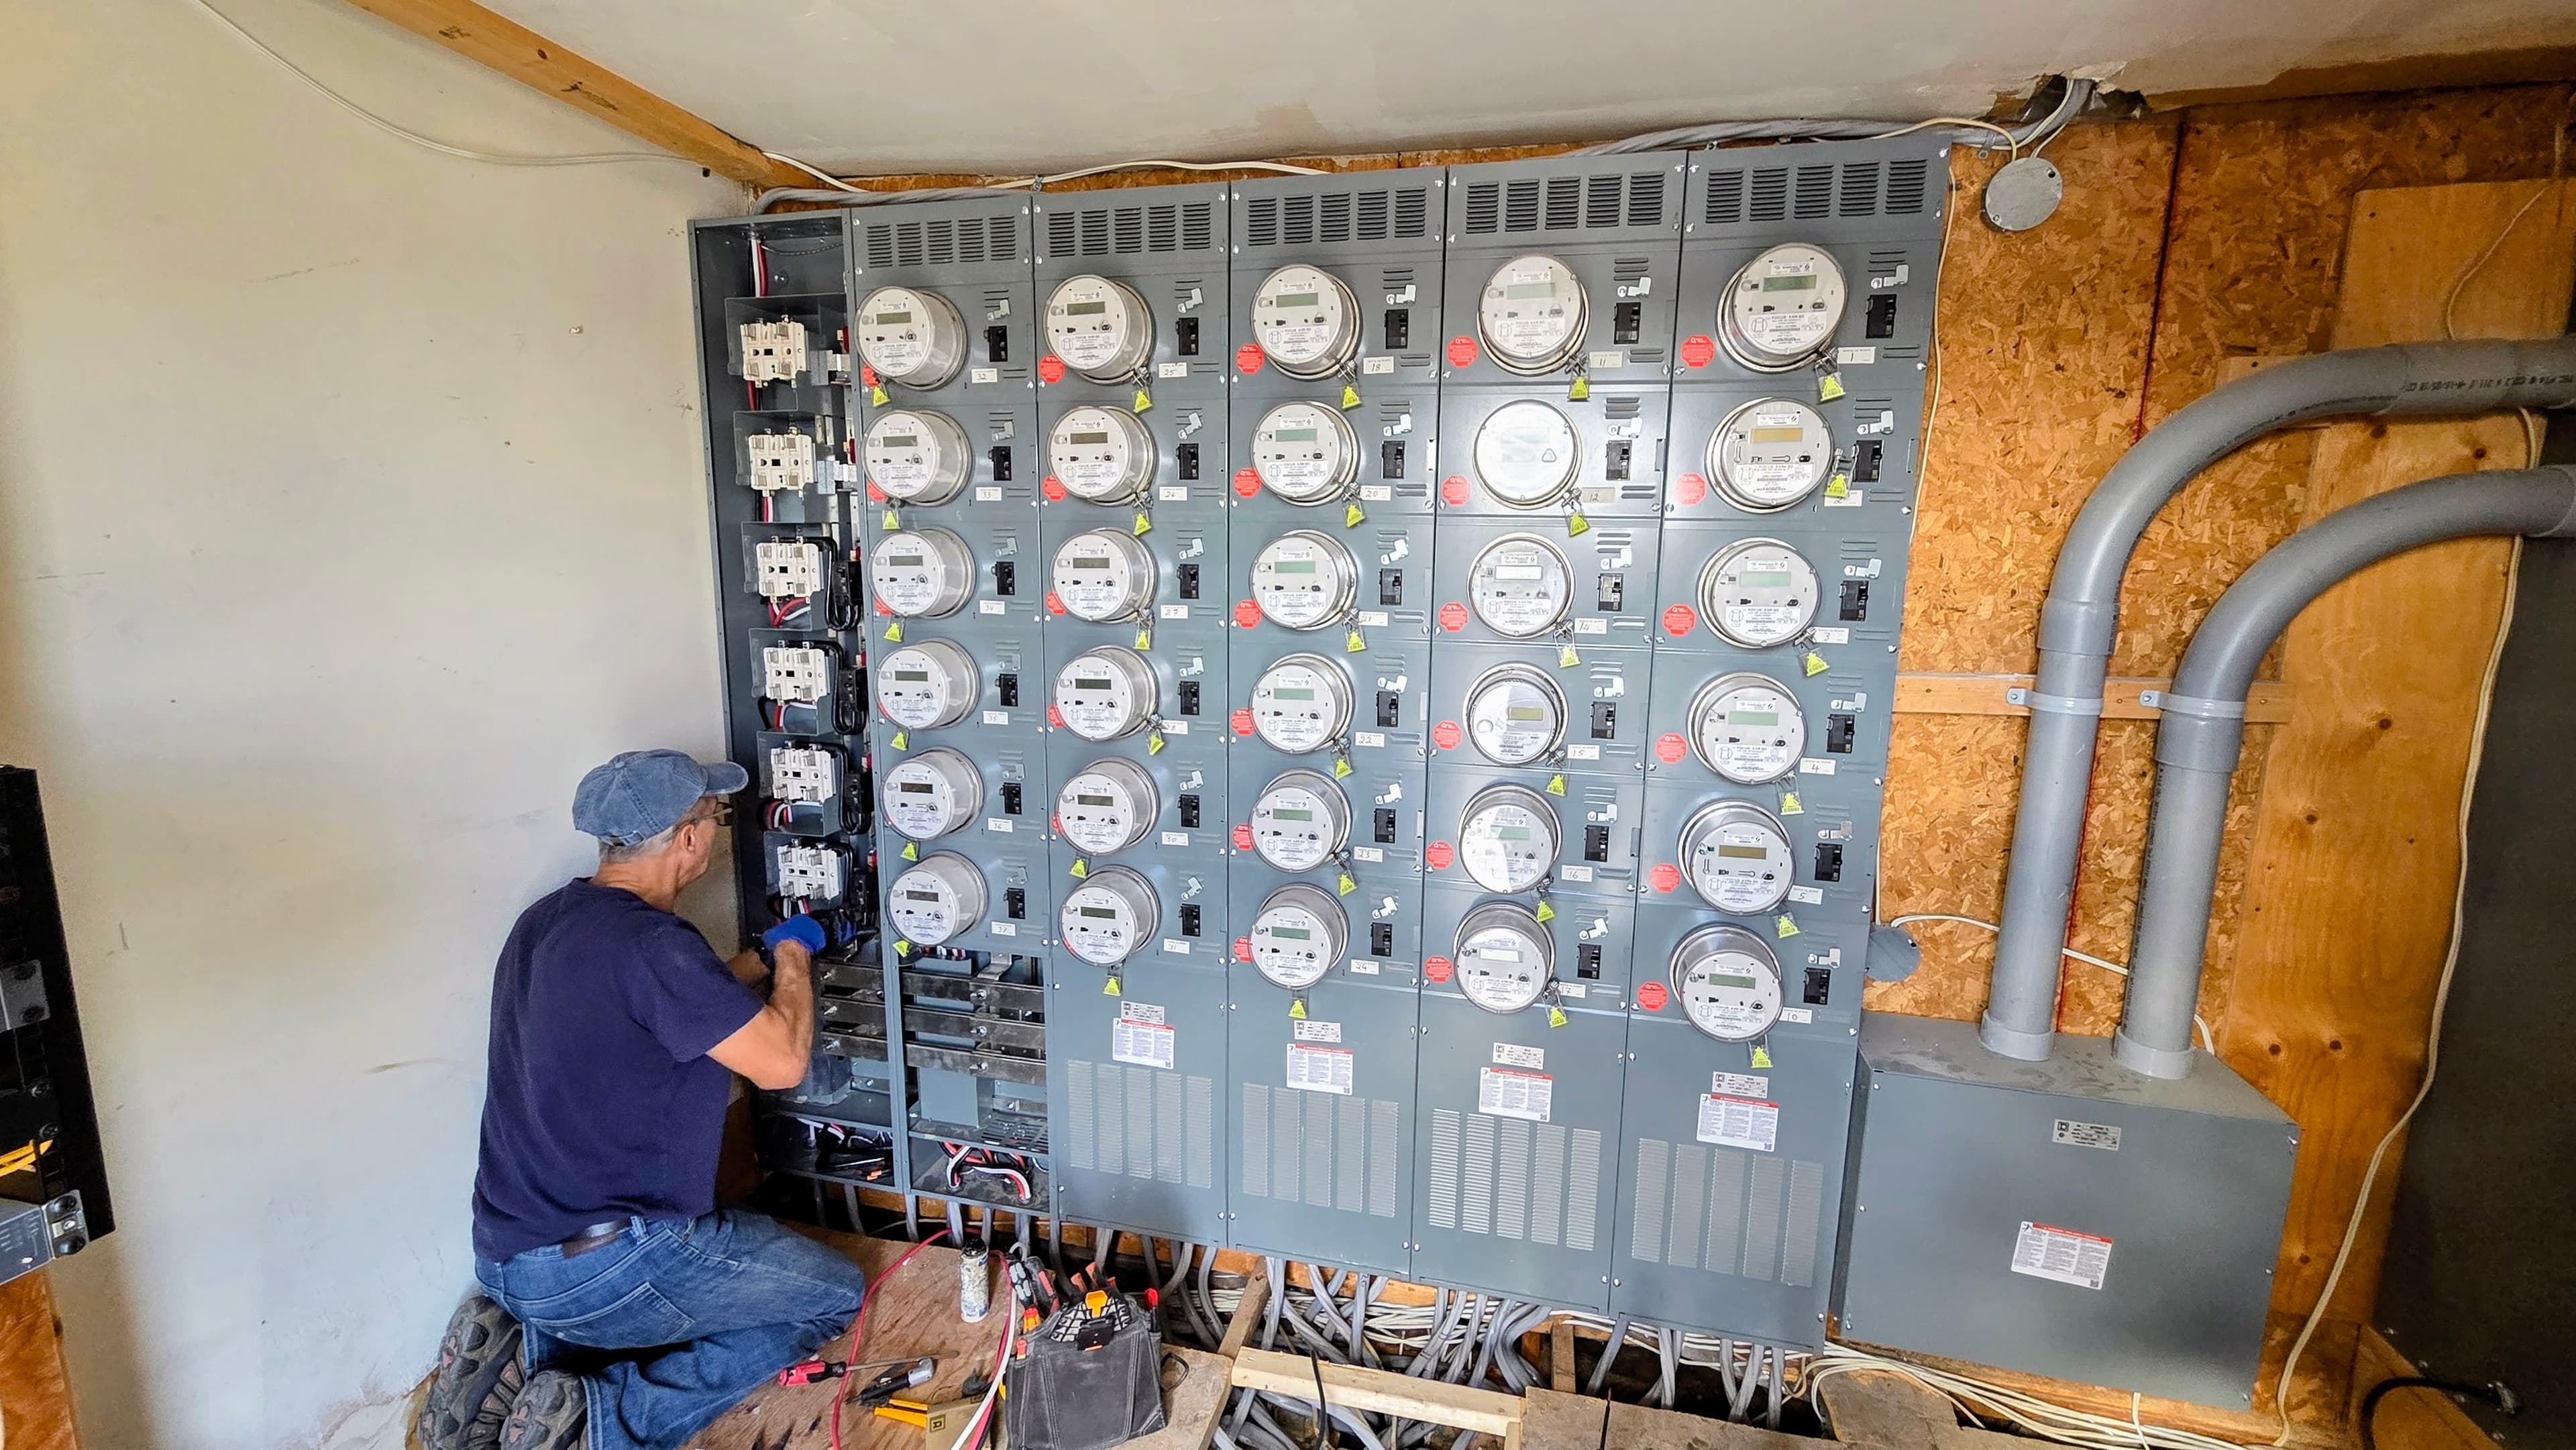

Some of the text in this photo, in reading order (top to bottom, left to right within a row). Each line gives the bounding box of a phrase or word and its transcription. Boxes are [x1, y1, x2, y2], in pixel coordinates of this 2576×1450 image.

[1371, 363, 1381, 372] 18
[1599, 358, 1606, 368] 11
[1365, 490, 1378, 498] 20
[1589, 493, 1599, 502] 12
[1823, 632, 1831, 641] 3
[1812, 763, 1819, 773] 4
[1568, 871, 1578, 879] 16
[1798, 892, 1807, 900] 5
[1788, 1012, 1798, 1021] 10
